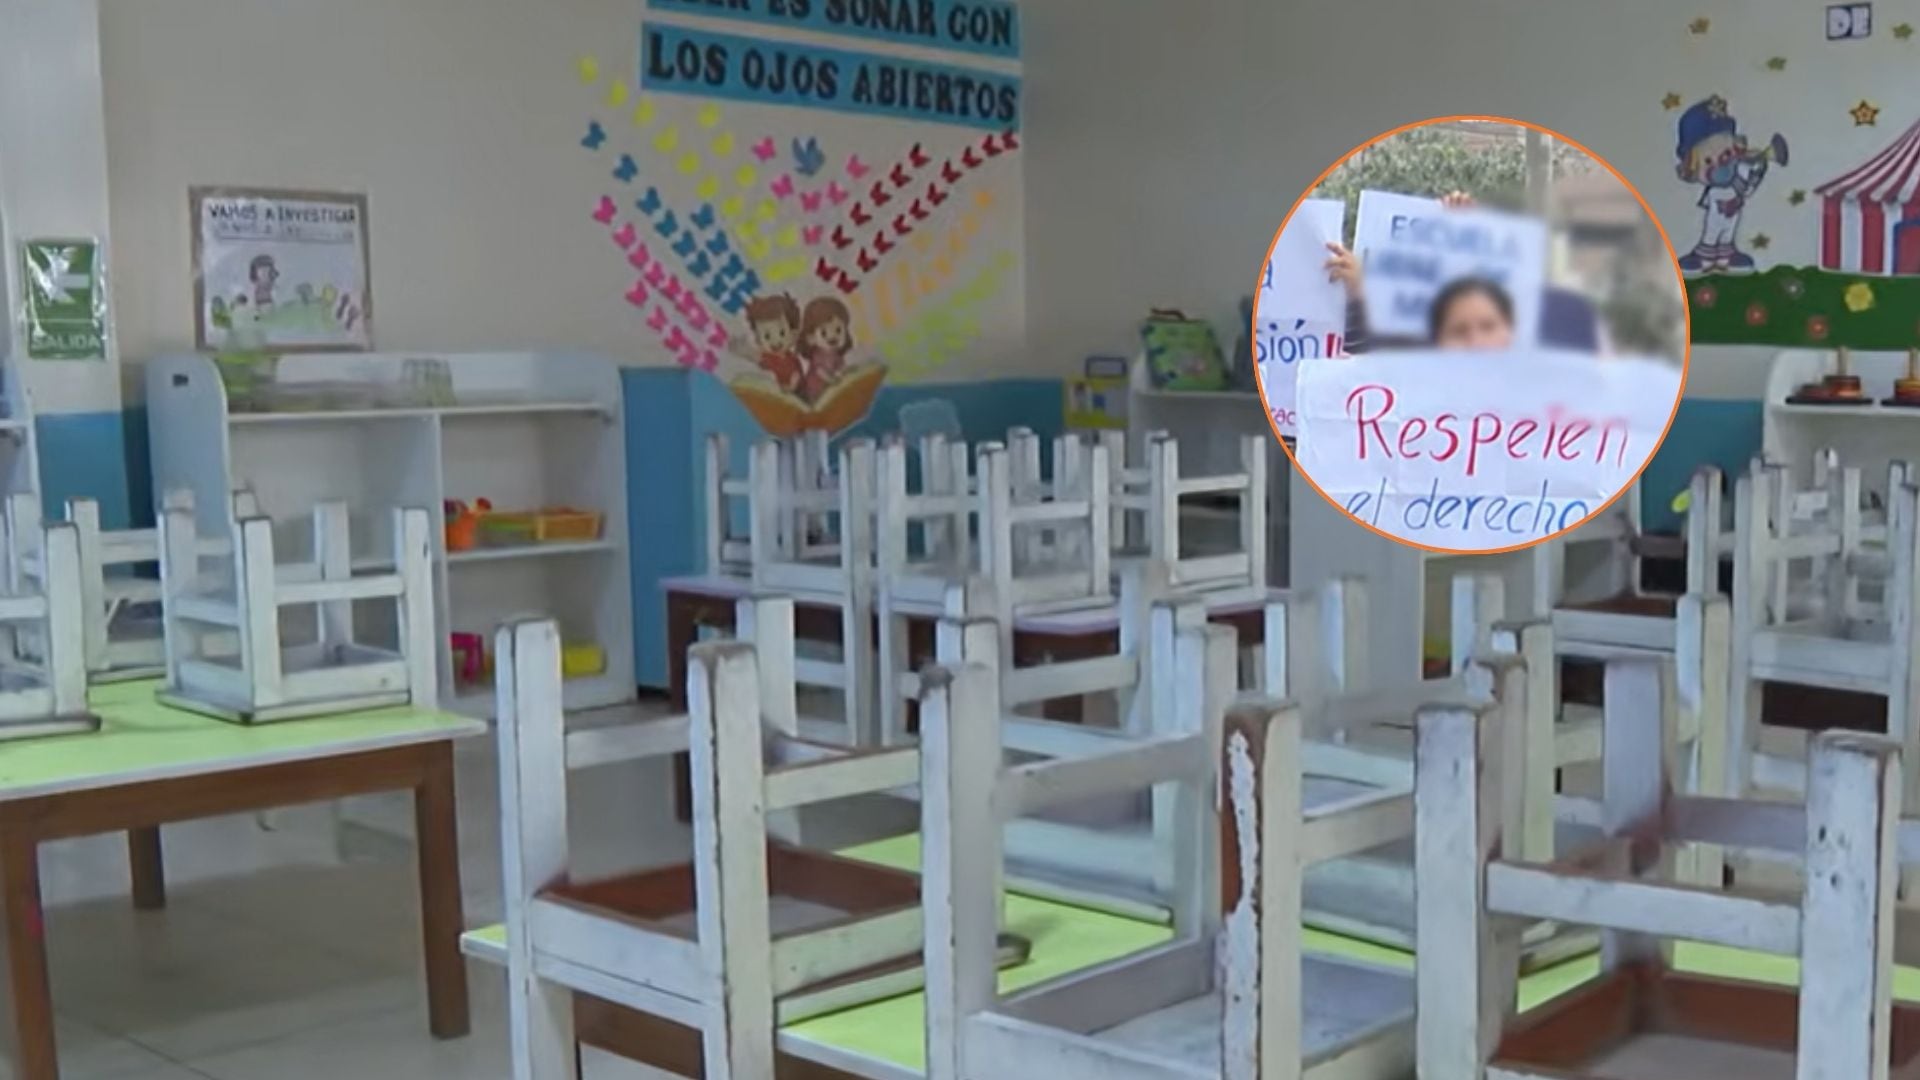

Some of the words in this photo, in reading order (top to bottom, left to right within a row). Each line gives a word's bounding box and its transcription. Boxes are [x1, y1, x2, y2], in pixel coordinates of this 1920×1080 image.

[947, 4, 1011, 46] CON
[1828, 5, 1870, 39] DE
[649, 32, 728, 86] LOS
[742, 48, 839, 99] OJOS
[853, 63, 1016, 122] ABIERTOS
[208, 203, 258, 220] VAMOS
[265, 207, 275, 221] A
[278, 206, 356, 223] INVESTIGAR
[31, 334, 102, 351] SALIDA
[1403, 477, 1588, 535] derecho
